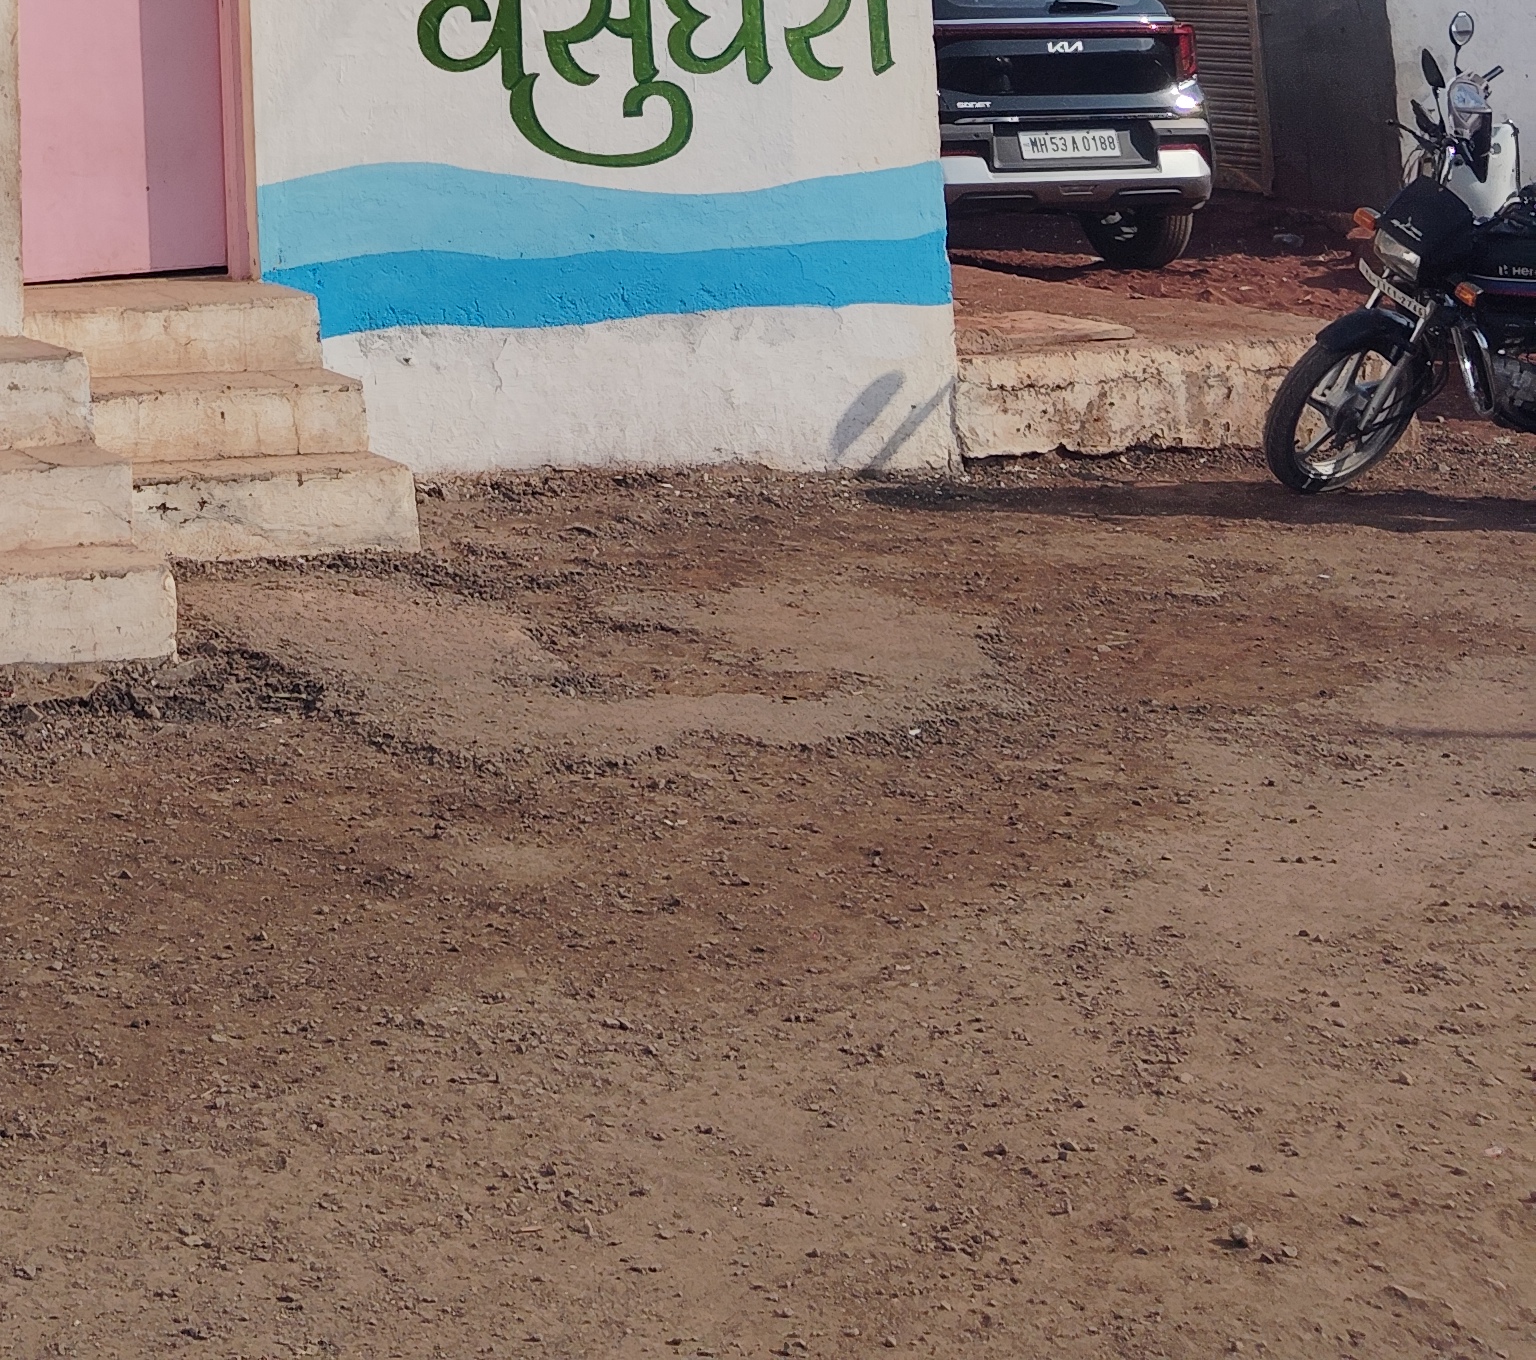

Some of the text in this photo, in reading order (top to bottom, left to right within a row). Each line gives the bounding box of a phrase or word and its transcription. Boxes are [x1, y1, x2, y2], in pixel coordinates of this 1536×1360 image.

[1046, 40, 1084, 54] KIA
[1028, 135, 1117, 153] MH 53 A 0188
[1512, 266, 1536, 277] Her
